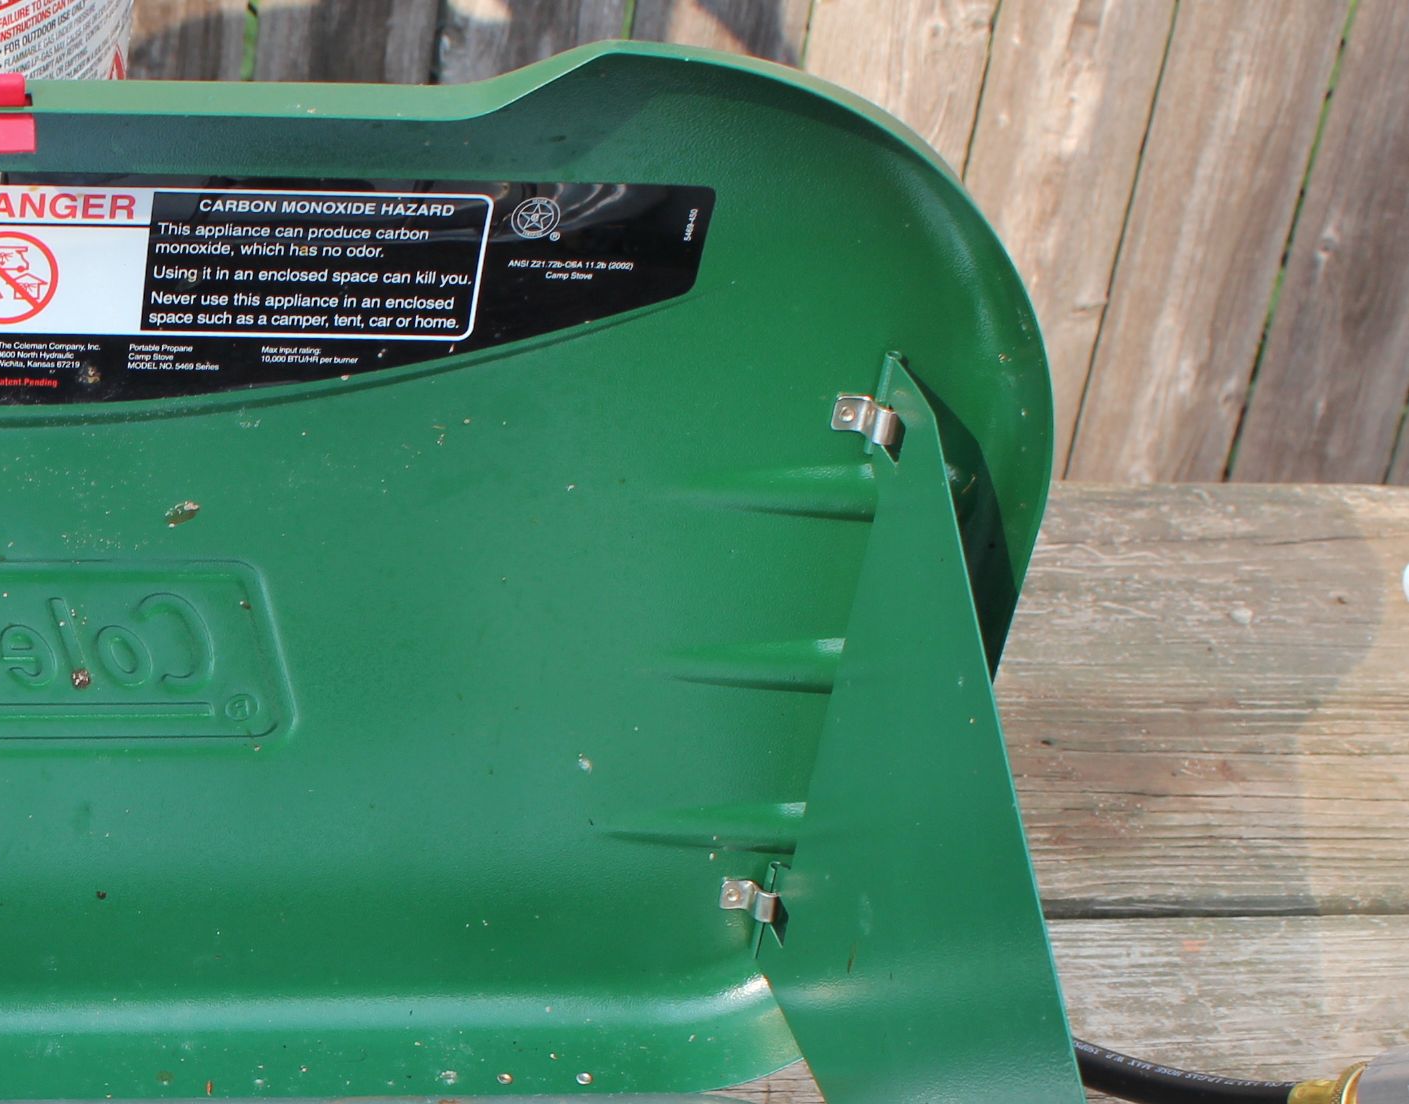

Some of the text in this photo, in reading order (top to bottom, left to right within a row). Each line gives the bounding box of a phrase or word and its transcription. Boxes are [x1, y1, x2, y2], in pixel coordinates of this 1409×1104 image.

[32, 2, 42, 14] TO
[52, 1, 65, 14] CAN
[4, 40, 20, 56] FOR
[22, 18, 56, 46] OUTDOOR
[57, 10, 70, 26] USE
[71, 0, 85, 18] ONLY
[4, 37, 54, 69] FLAMMABLE GAS
[199, 200, 454, 216] CARBON MONOXIDE HAZARD
[158, 222, 429, 241] This appliance can produce carbon
[155, 242, 384, 258] monoxide, which has no odor.
[153, 266, 472, 287] Using it in an enclosed space can kill you.
[545, 271, 592, 281] Camp Stove
[150, 292, 454, 310] Never use this appliance in an enclosed
[149, 312, 459, 329] space such as a camper, tent, car or home.
[48, 343, 85, 352] Company,
[161, 344, 192, 353] Propane
[278, 346, 297, 355] input
[298, 346, 321, 355] rating:
[39, 352, 73, 361] Hydraulic
[128, 353, 151, 362] Camp
[262, 355, 285, 363] 10,000
[23, 378, 57, 388] Pending
